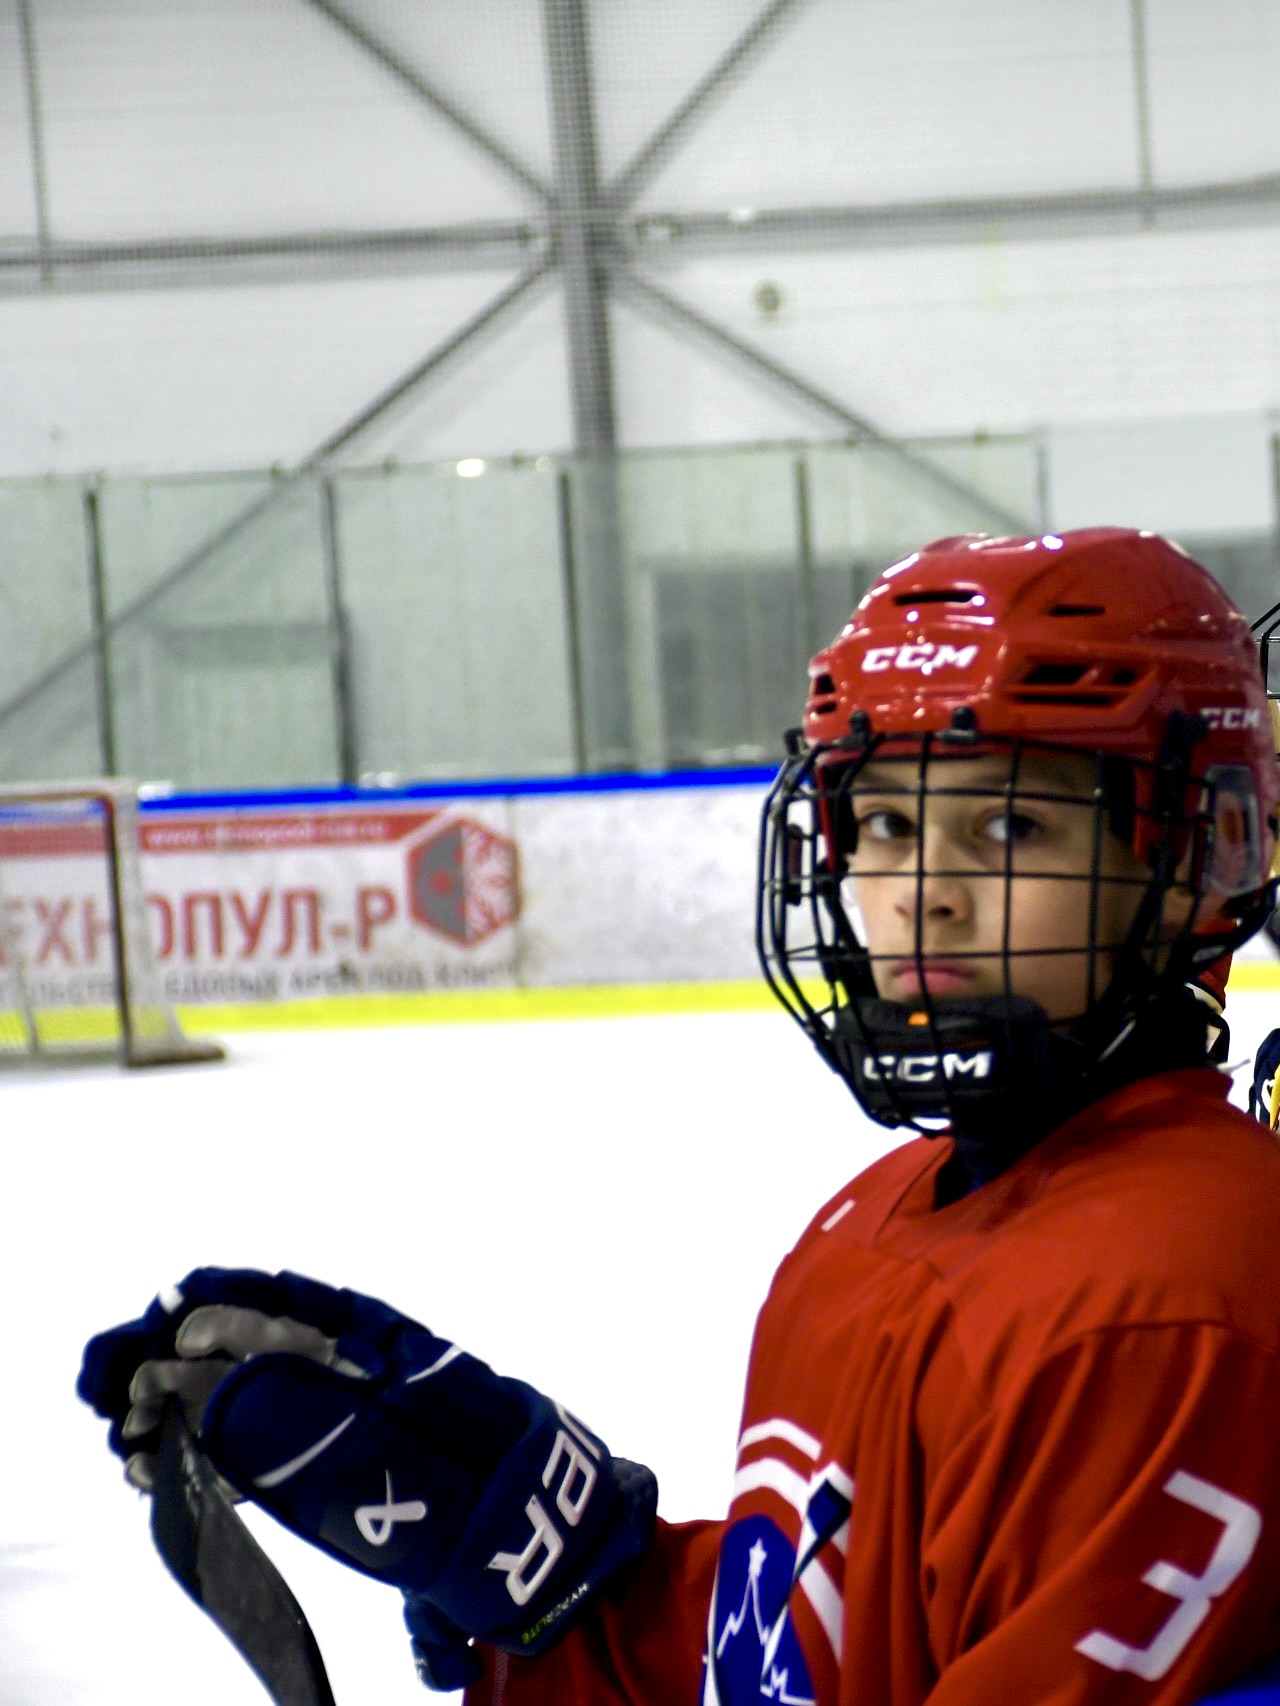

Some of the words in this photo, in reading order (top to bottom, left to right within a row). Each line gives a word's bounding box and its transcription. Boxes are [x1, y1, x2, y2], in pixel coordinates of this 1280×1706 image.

[861, 643, 979, 673] CCM
[863, 1052, 992, 1082] CCM
[1073, 1468, 1262, 1682] 3
